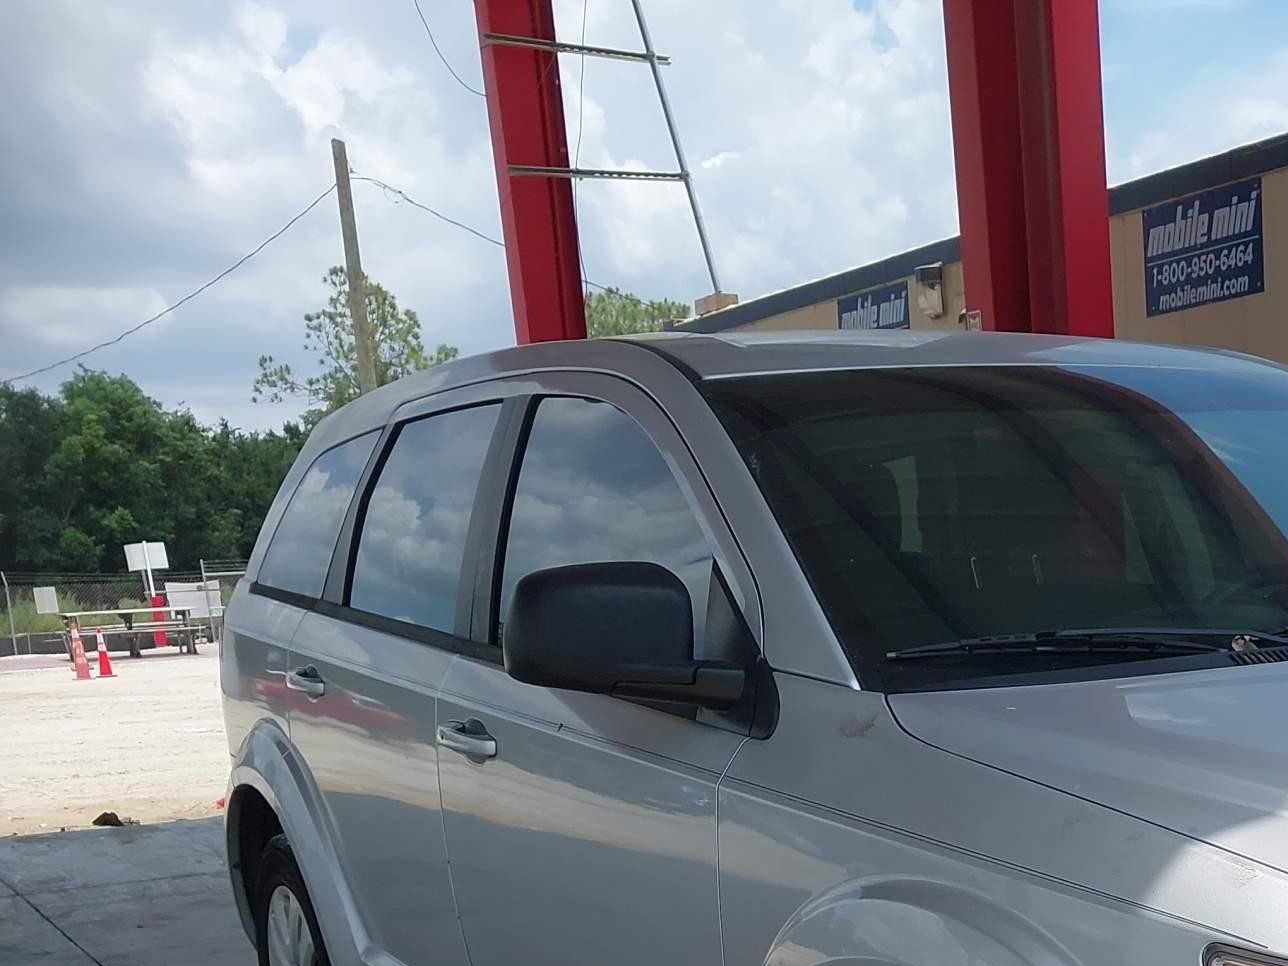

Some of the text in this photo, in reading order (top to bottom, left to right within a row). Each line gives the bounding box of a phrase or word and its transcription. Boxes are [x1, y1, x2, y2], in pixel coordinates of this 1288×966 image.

[1147, 190, 1257, 257] mobile mini
[1152, 243, 1253, 287] 1-800-950-6464
[879, 290, 907, 327] mini
[1159, 276, 1249, 310] mobilemini.com
